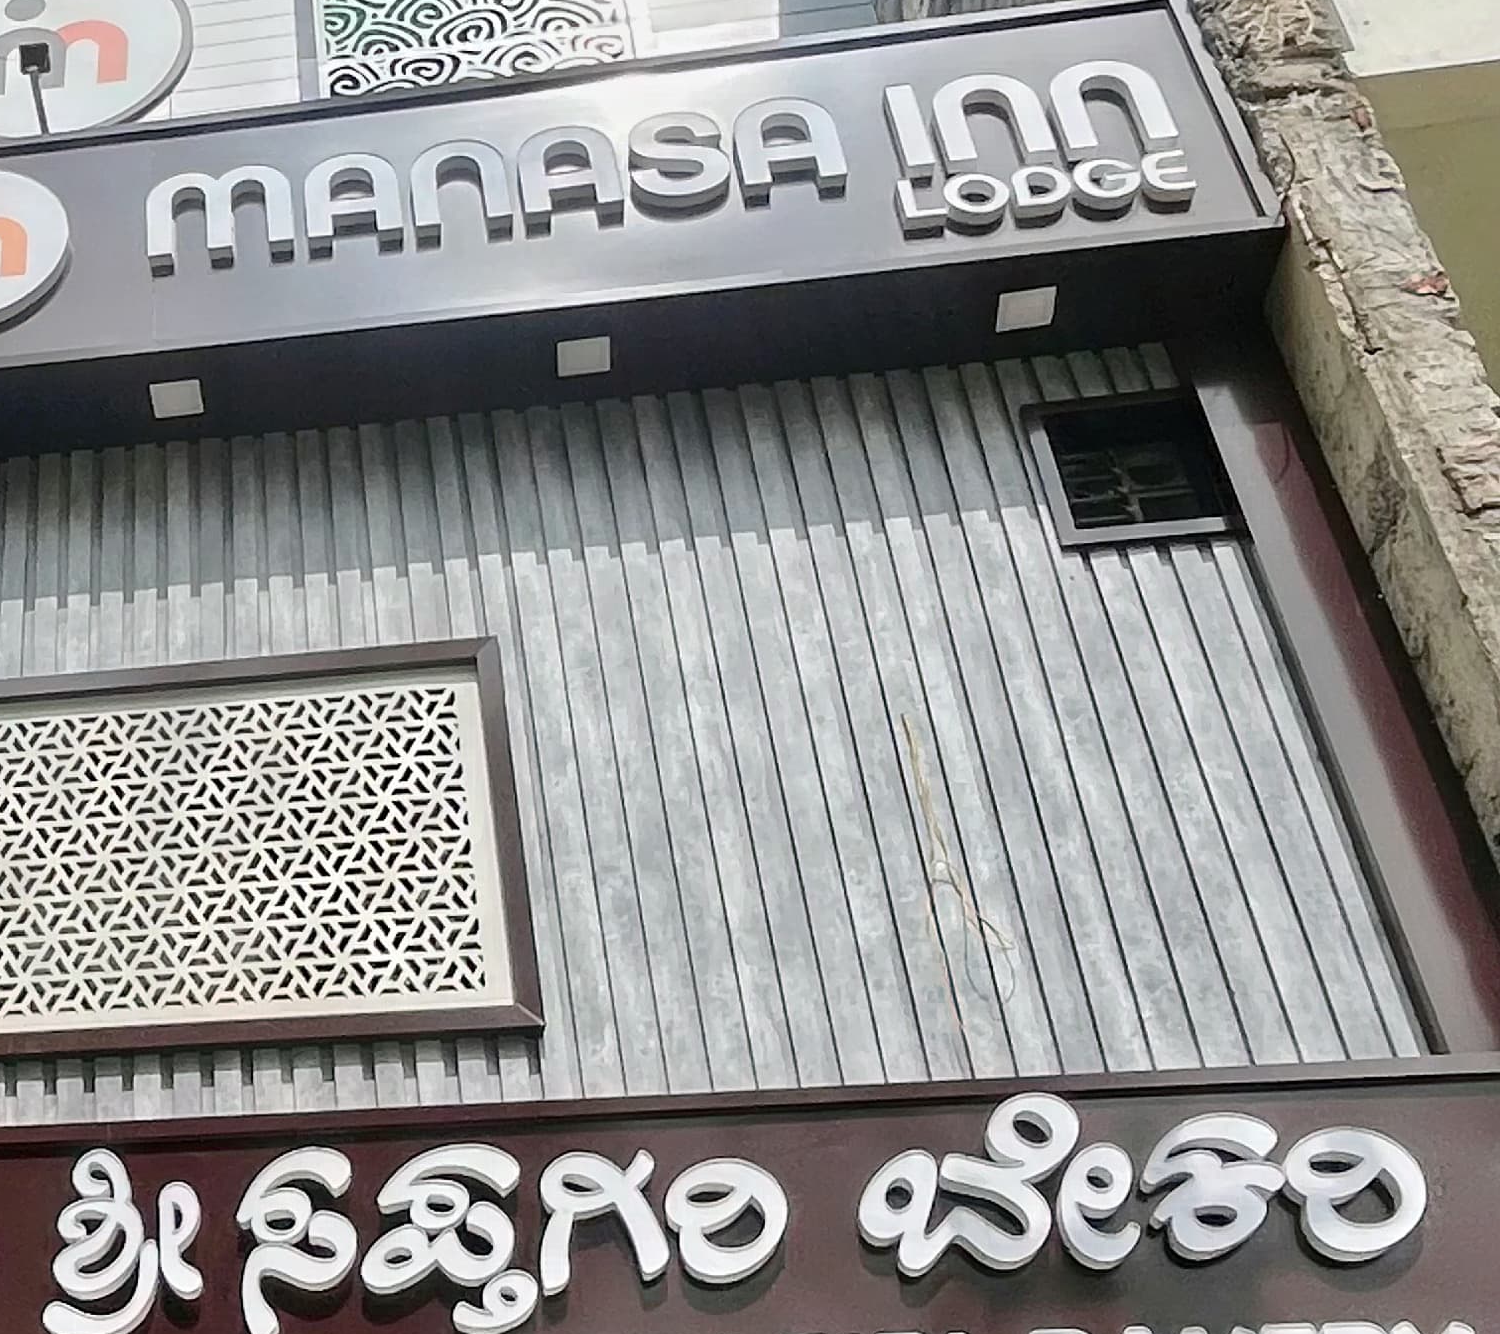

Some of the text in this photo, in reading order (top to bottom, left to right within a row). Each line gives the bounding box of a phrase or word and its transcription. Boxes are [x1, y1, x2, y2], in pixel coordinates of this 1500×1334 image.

[146, 96, 847, 274] MANASA
[897, 149, 1198, 231] LODGE
[857, 1092, 1428, 1278] ಬೇಕರಿ
